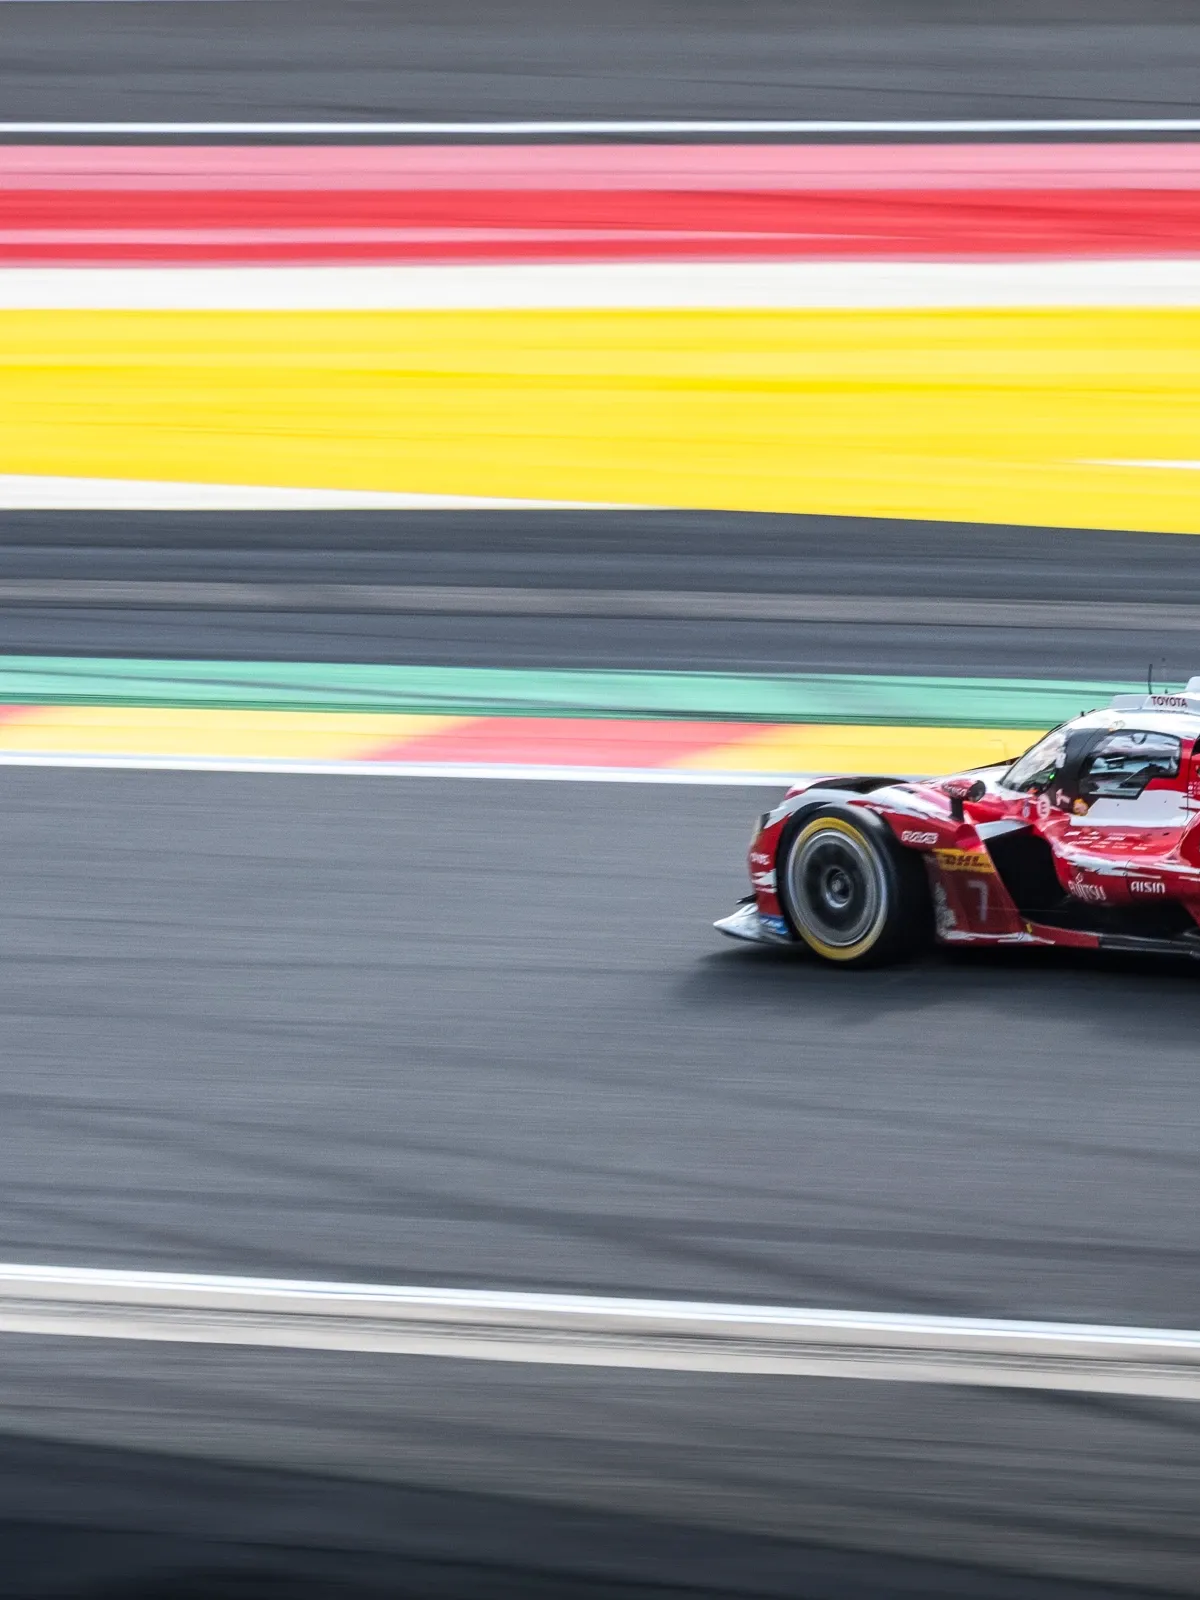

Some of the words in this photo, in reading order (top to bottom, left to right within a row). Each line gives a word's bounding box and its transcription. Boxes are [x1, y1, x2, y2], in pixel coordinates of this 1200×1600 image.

[1151, 696, 1188, 707] TOYOTA
[943, 854, 985, 867] DHL
[968, 880, 988, 921] 7
